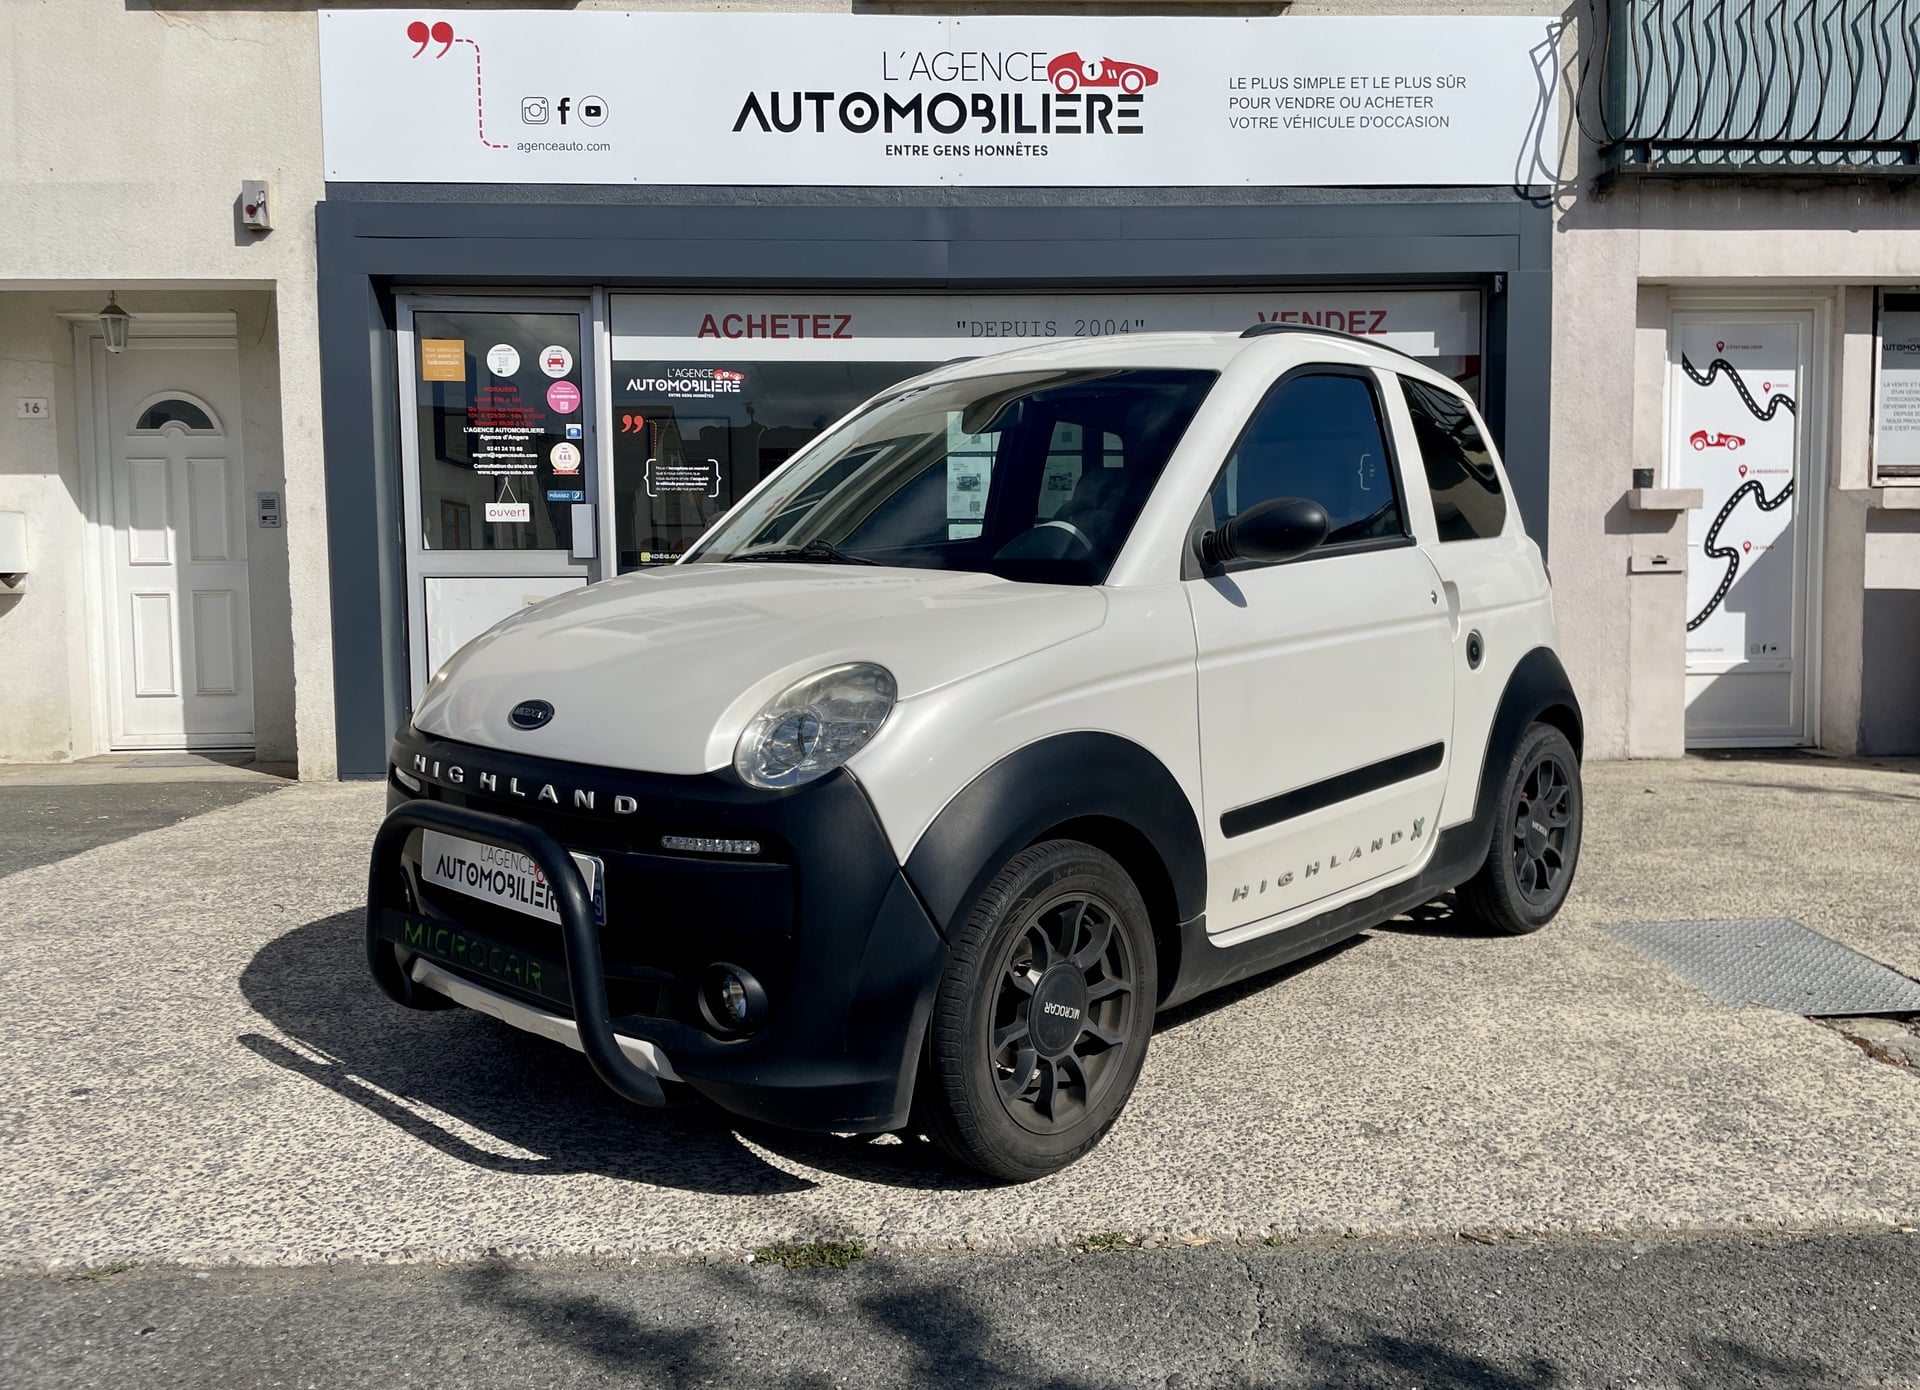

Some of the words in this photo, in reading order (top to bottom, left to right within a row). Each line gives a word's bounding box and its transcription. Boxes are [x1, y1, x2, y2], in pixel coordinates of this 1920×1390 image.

[883, 51, 1048, 82] L'AGENCE
[1229, 77, 1247, 89] LE
[1251, 77, 1289, 89] PLUS
[1293, 77, 1346, 89] SIMPLE
[1350, 77, 1368, 89] ET
[1372, 77, 1390, 89] LE
[1394, 77, 1432, 89] PLUS
[1436, 74, 1467, 89] SÛR
[1229, 97, 1271, 109] POUR
[1275, 97, 1335, 109] VENDRE
[1339, 97, 1361, 109] OU
[1364, 96, 1434, 109] ACHETER
[1229, 117, 1278, 129] VOTRE
[1283, 114, 1355, 129] VÉHICULE
[1359, 116, 1450, 128] D'OCCASION
[516, 139, 611, 153] agenceauto.com
[885, 144, 929, 157] ENTRE
[933, 144, 971, 157] GENS
[974, 141, 1049, 157] HONNÊTES
[697, 313, 853, 339] ACHETEZ
[667, 368, 713, 378] L'AGENCE
[24, 402, 40, 414] 16
[489, 508, 526, 517] ouvert
[413, 753, 638, 815] HIGHLAND
[480, 844, 535, 876] L'AGENCE
[436, 854, 561, 912] AUTOMOBILIER
[404, 919, 542, 993] MICROCAR
[1044, 1001, 1080, 1020] MICROCAR
